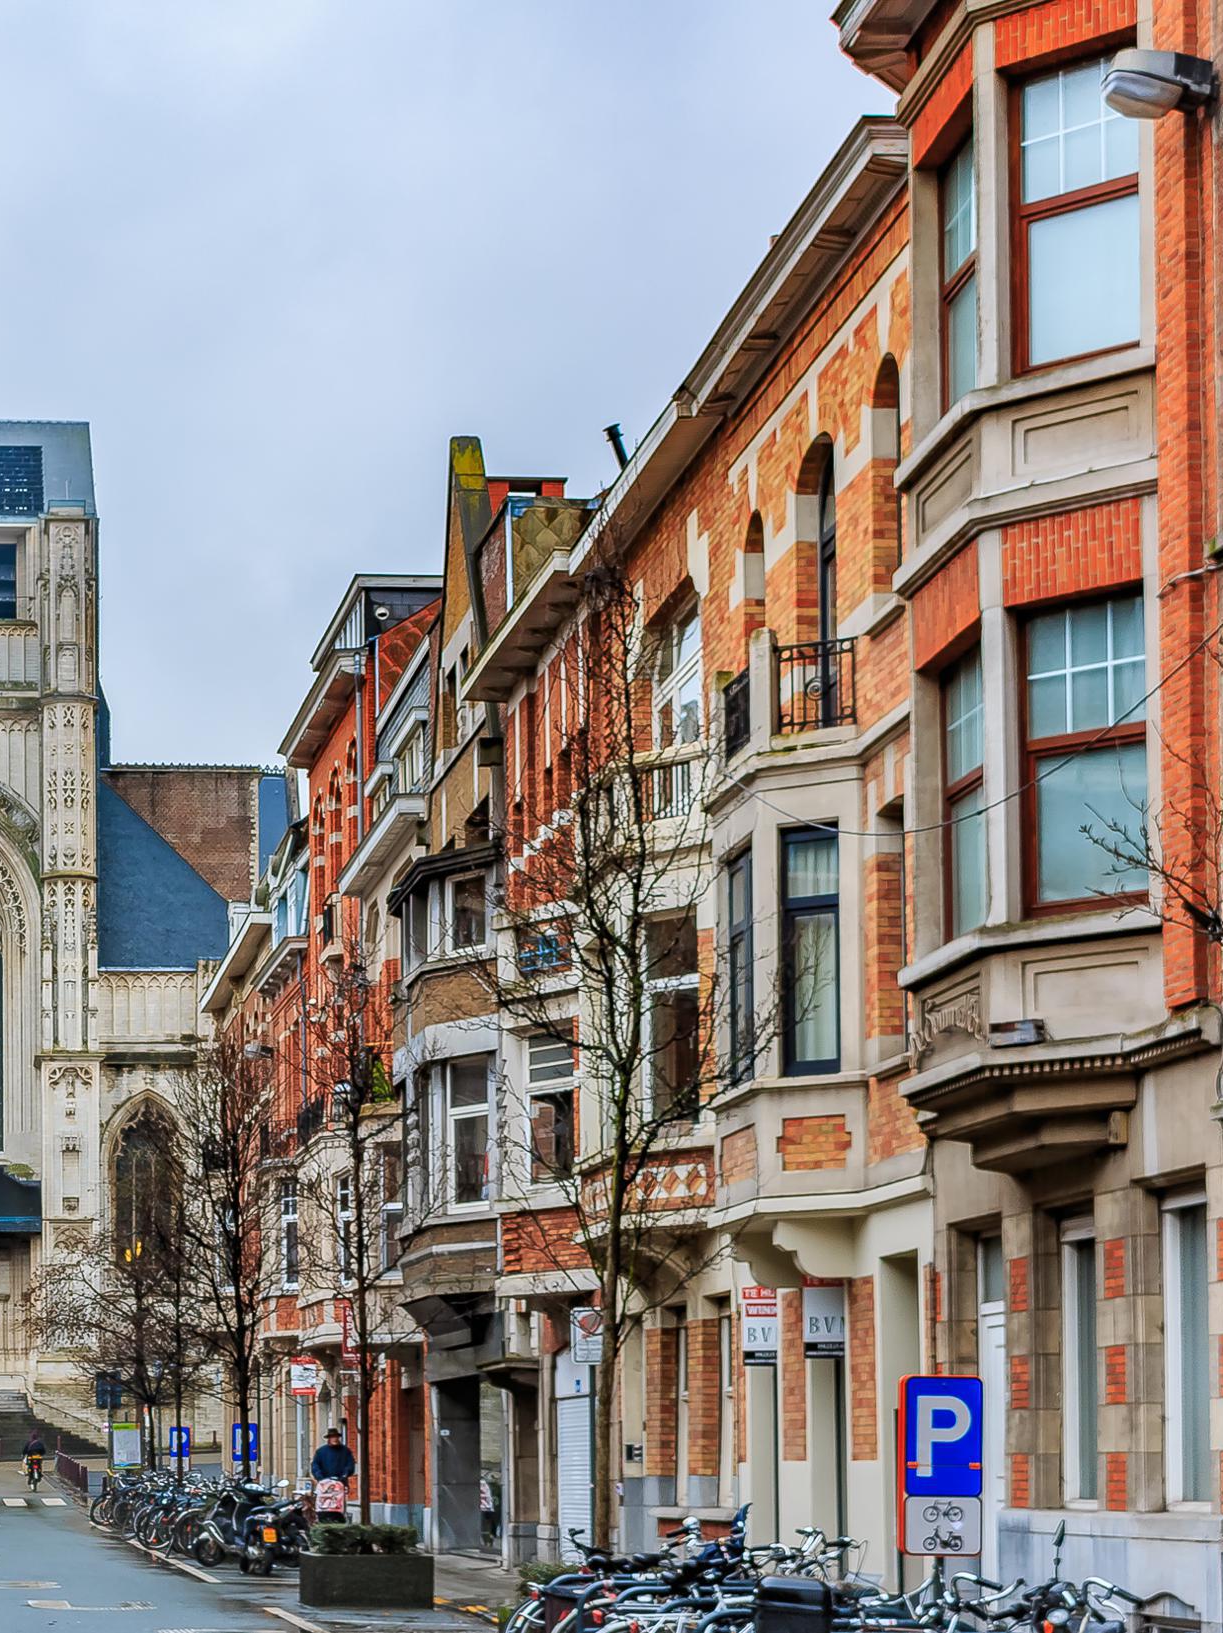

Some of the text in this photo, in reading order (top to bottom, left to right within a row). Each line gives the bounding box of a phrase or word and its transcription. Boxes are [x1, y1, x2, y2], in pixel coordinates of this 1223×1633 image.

[172, 1431, 188, 1452] P
[235, 1428, 254, 1455] P
[916, 1395, 971, 1477] P
